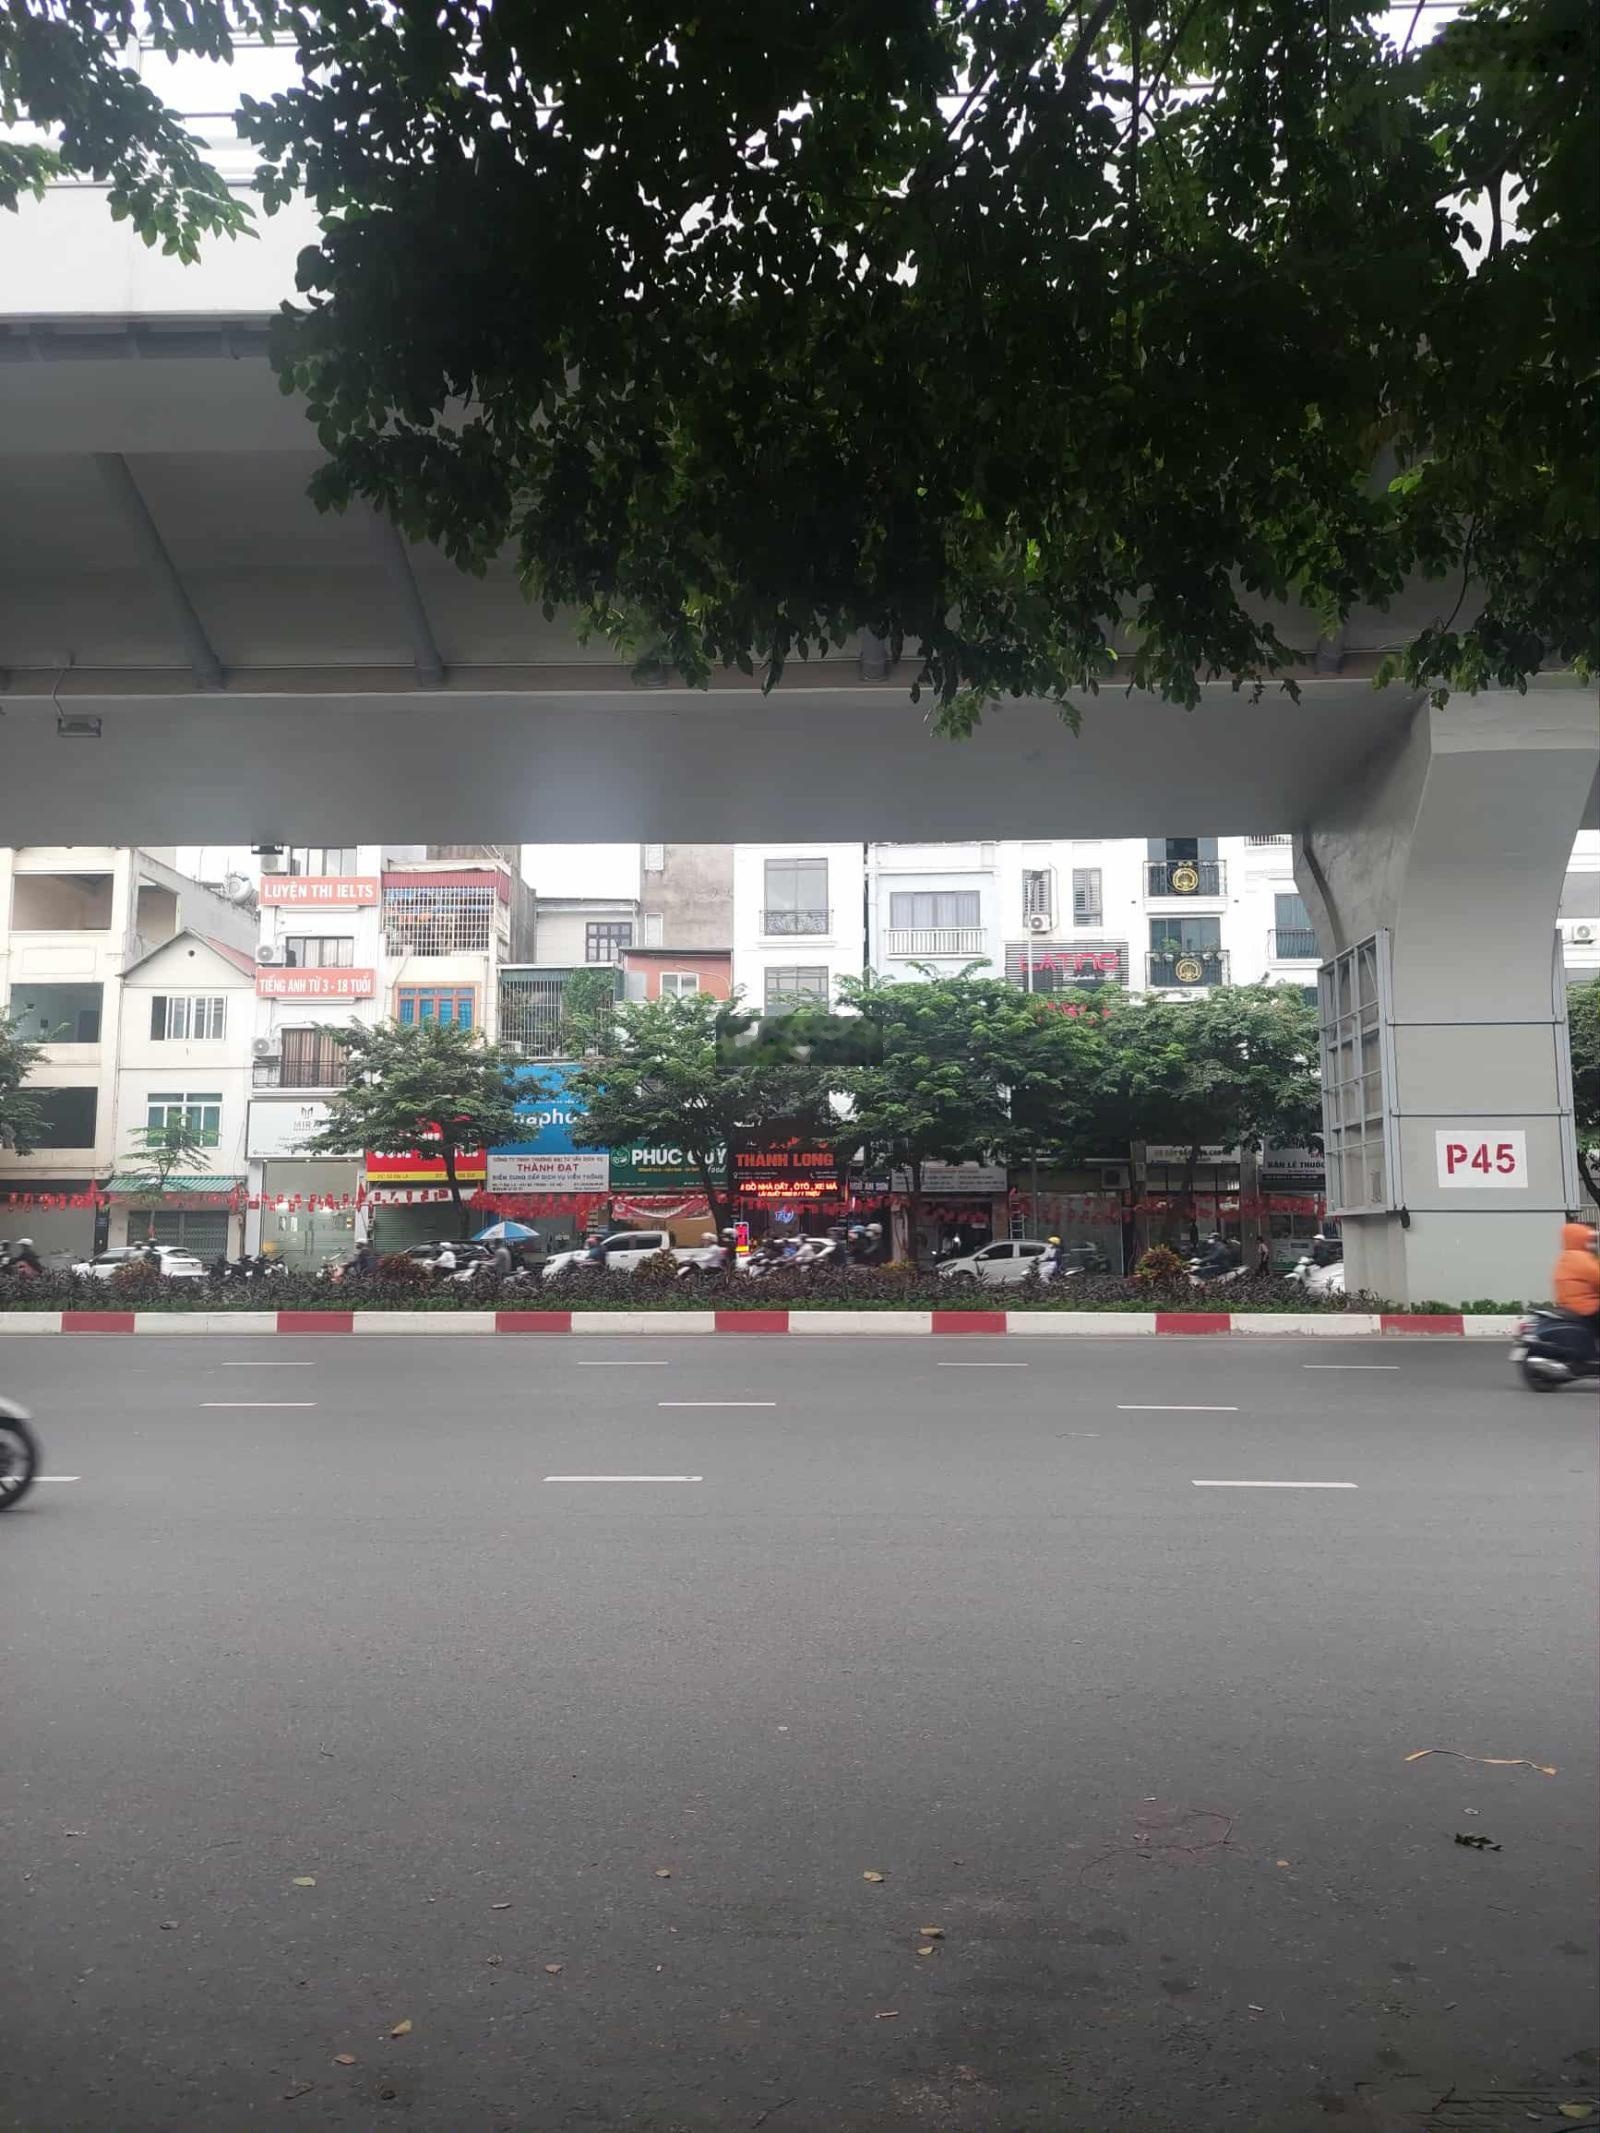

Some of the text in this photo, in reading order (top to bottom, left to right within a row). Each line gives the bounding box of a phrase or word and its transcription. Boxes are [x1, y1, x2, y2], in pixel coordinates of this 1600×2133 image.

[264, 881, 373, 901] LUYỆN THI IELTS
[260, 974, 286, 993] TIẾNG
[288, 980, 306, 993] ANH
[309, 976, 320, 993] TỪ
[322, 980, 328, 993] 3
[338, 979, 347, 993] 18
[632, 1144, 682, 1165] PHÚC
[793, 1153, 834, 1166] LONG
[1446, 1143, 1515, 1174] P45
[517, 1162, 579, 1174] THÀNH ĐẠT
[707, 1165, 727, 1174] food
